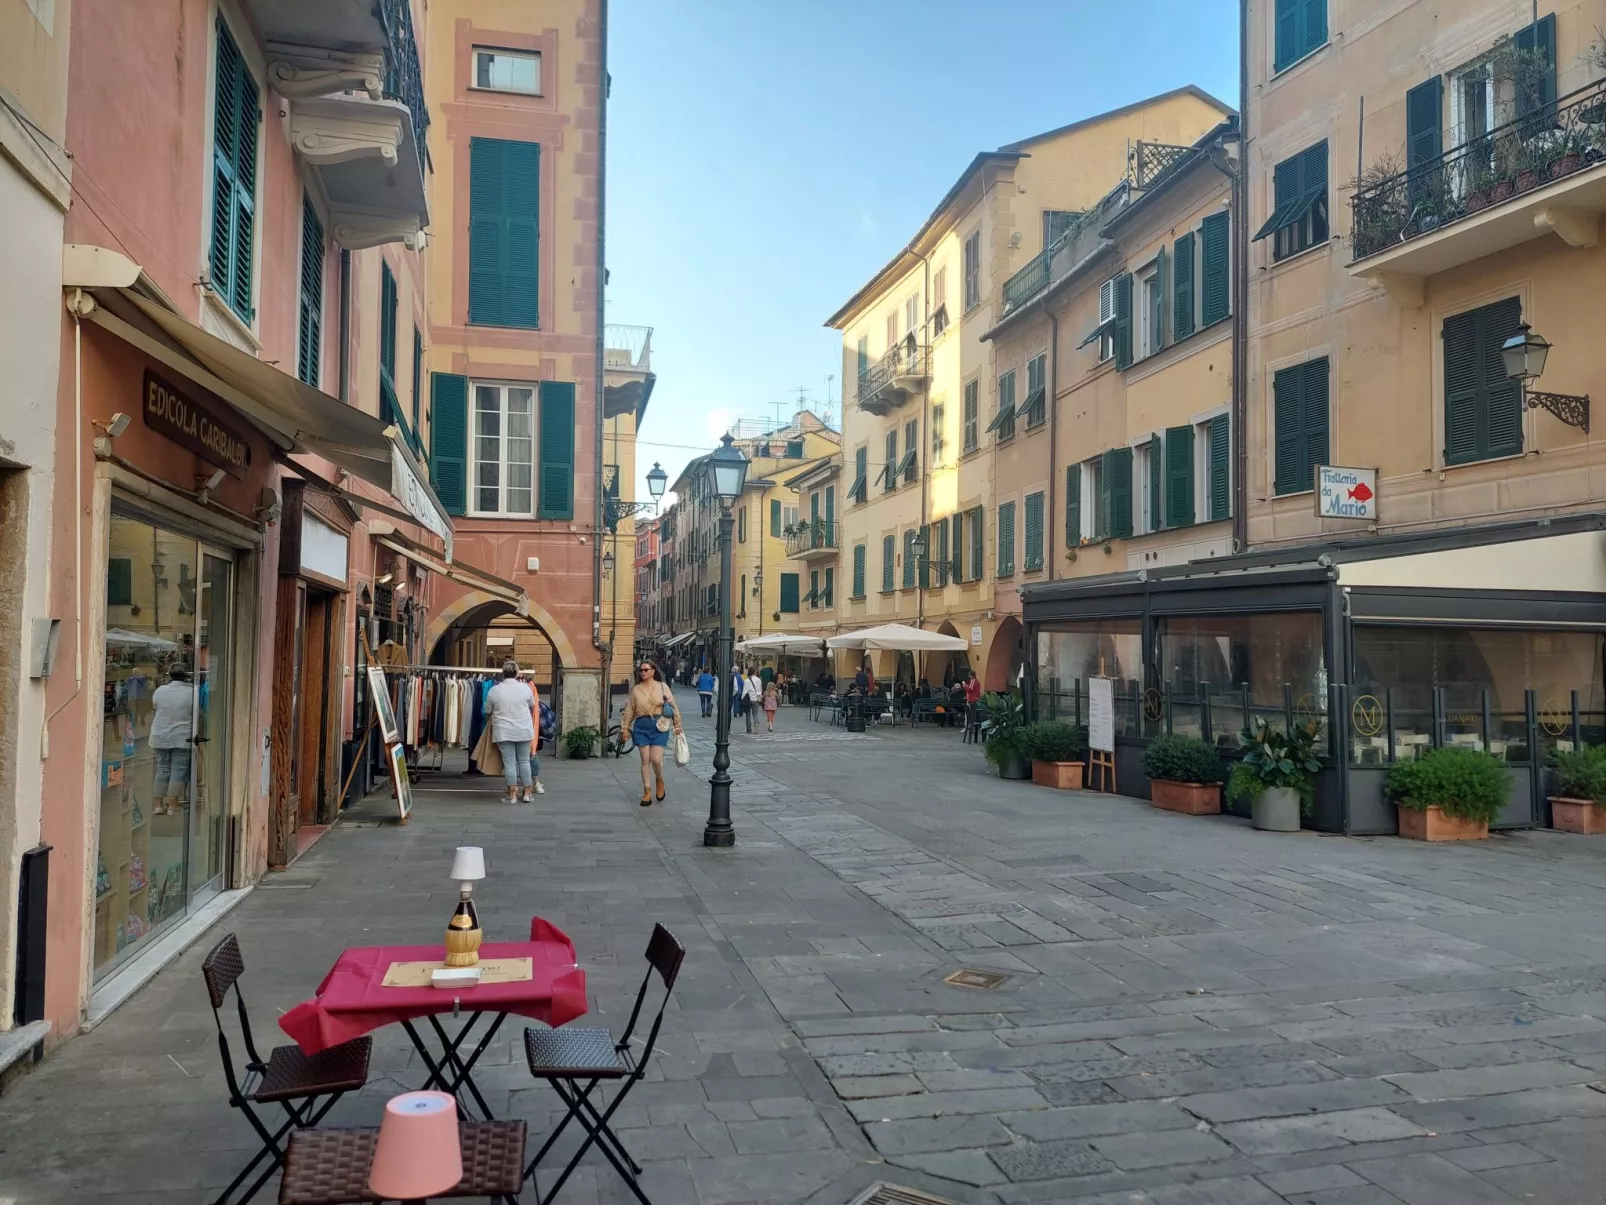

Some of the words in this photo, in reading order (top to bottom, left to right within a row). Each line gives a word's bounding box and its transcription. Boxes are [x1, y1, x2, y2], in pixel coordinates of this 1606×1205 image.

[148, 381, 197, 437] EDICOLA
[200, 417, 246, 468] GARIBALDI
[1320, 469, 1357, 484] Trattoria
[1321, 485, 1331, 496] da
[1325, 493, 1367, 516] Mario
[1355, 700, 1379, 732] M
